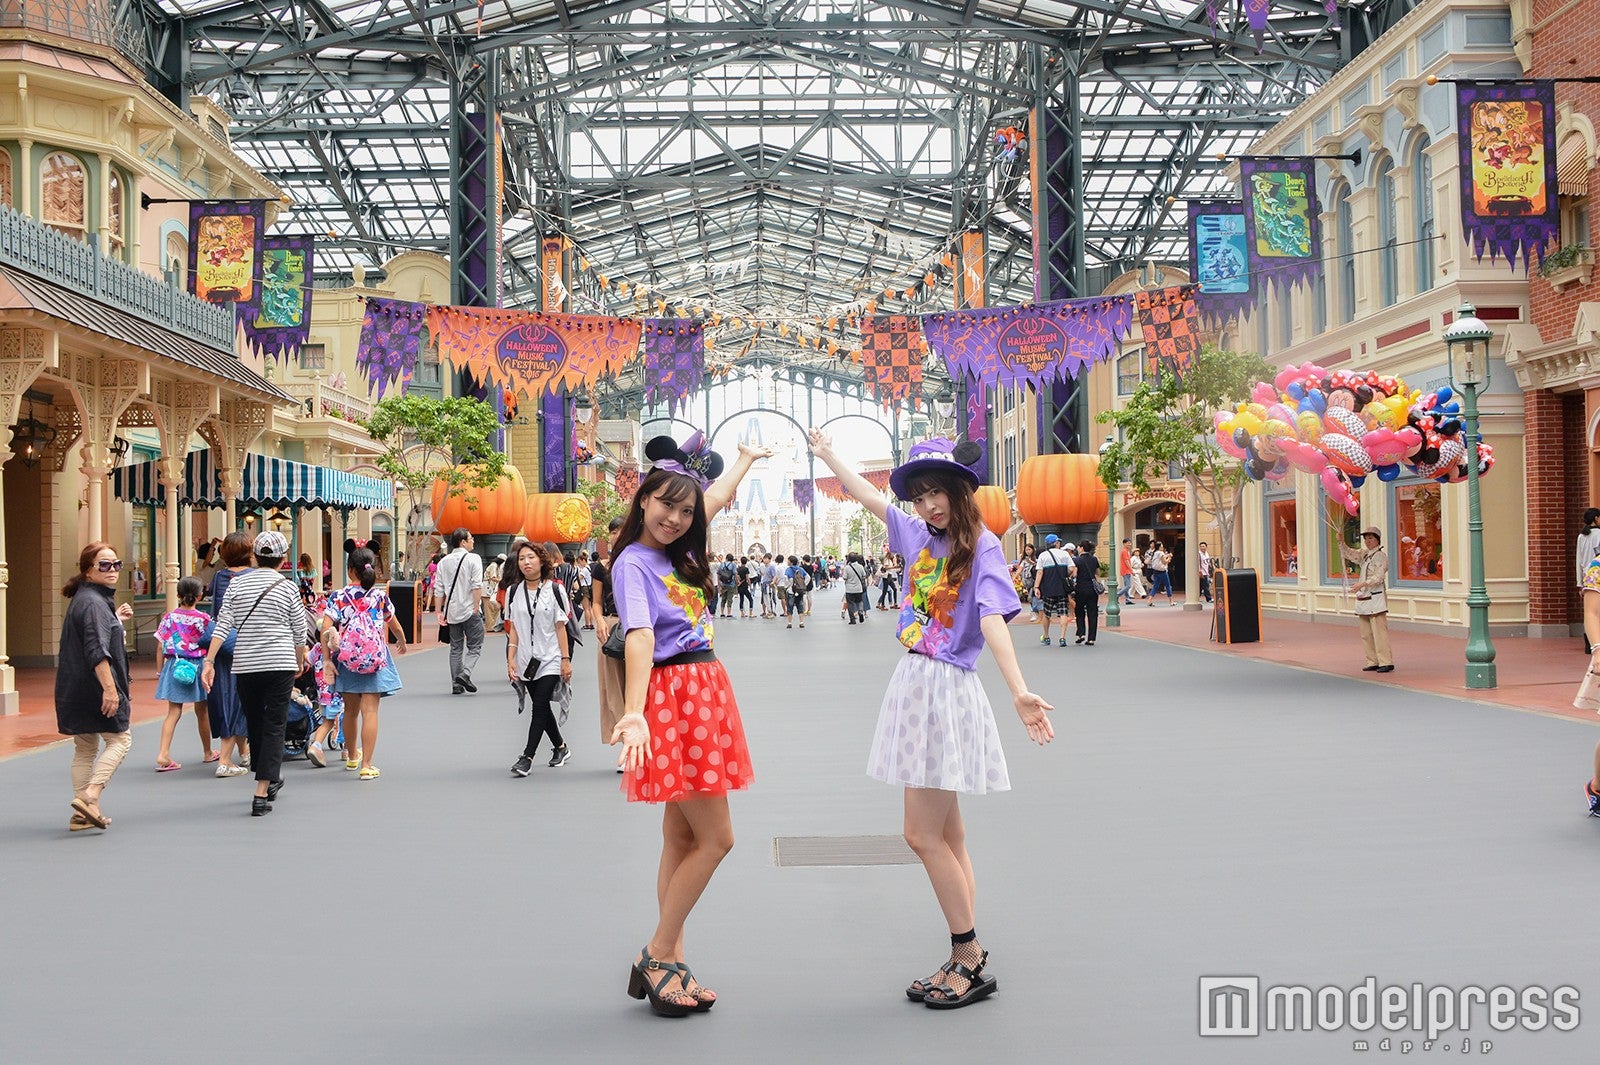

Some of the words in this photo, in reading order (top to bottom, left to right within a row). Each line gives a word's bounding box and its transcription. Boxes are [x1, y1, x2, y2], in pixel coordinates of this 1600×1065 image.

[1006, 333, 1058, 346] HALLOWEEN
[506, 341, 558, 353] HALLOWEEN
[1019, 343, 1046, 354] MUSIC
[517, 351, 545, 361] MUSIC
[1015, 351, 1054, 364] FESTIVAL
[511, 359, 550, 371] FESTIVAL
[521, 369, 541, 379] 2016
